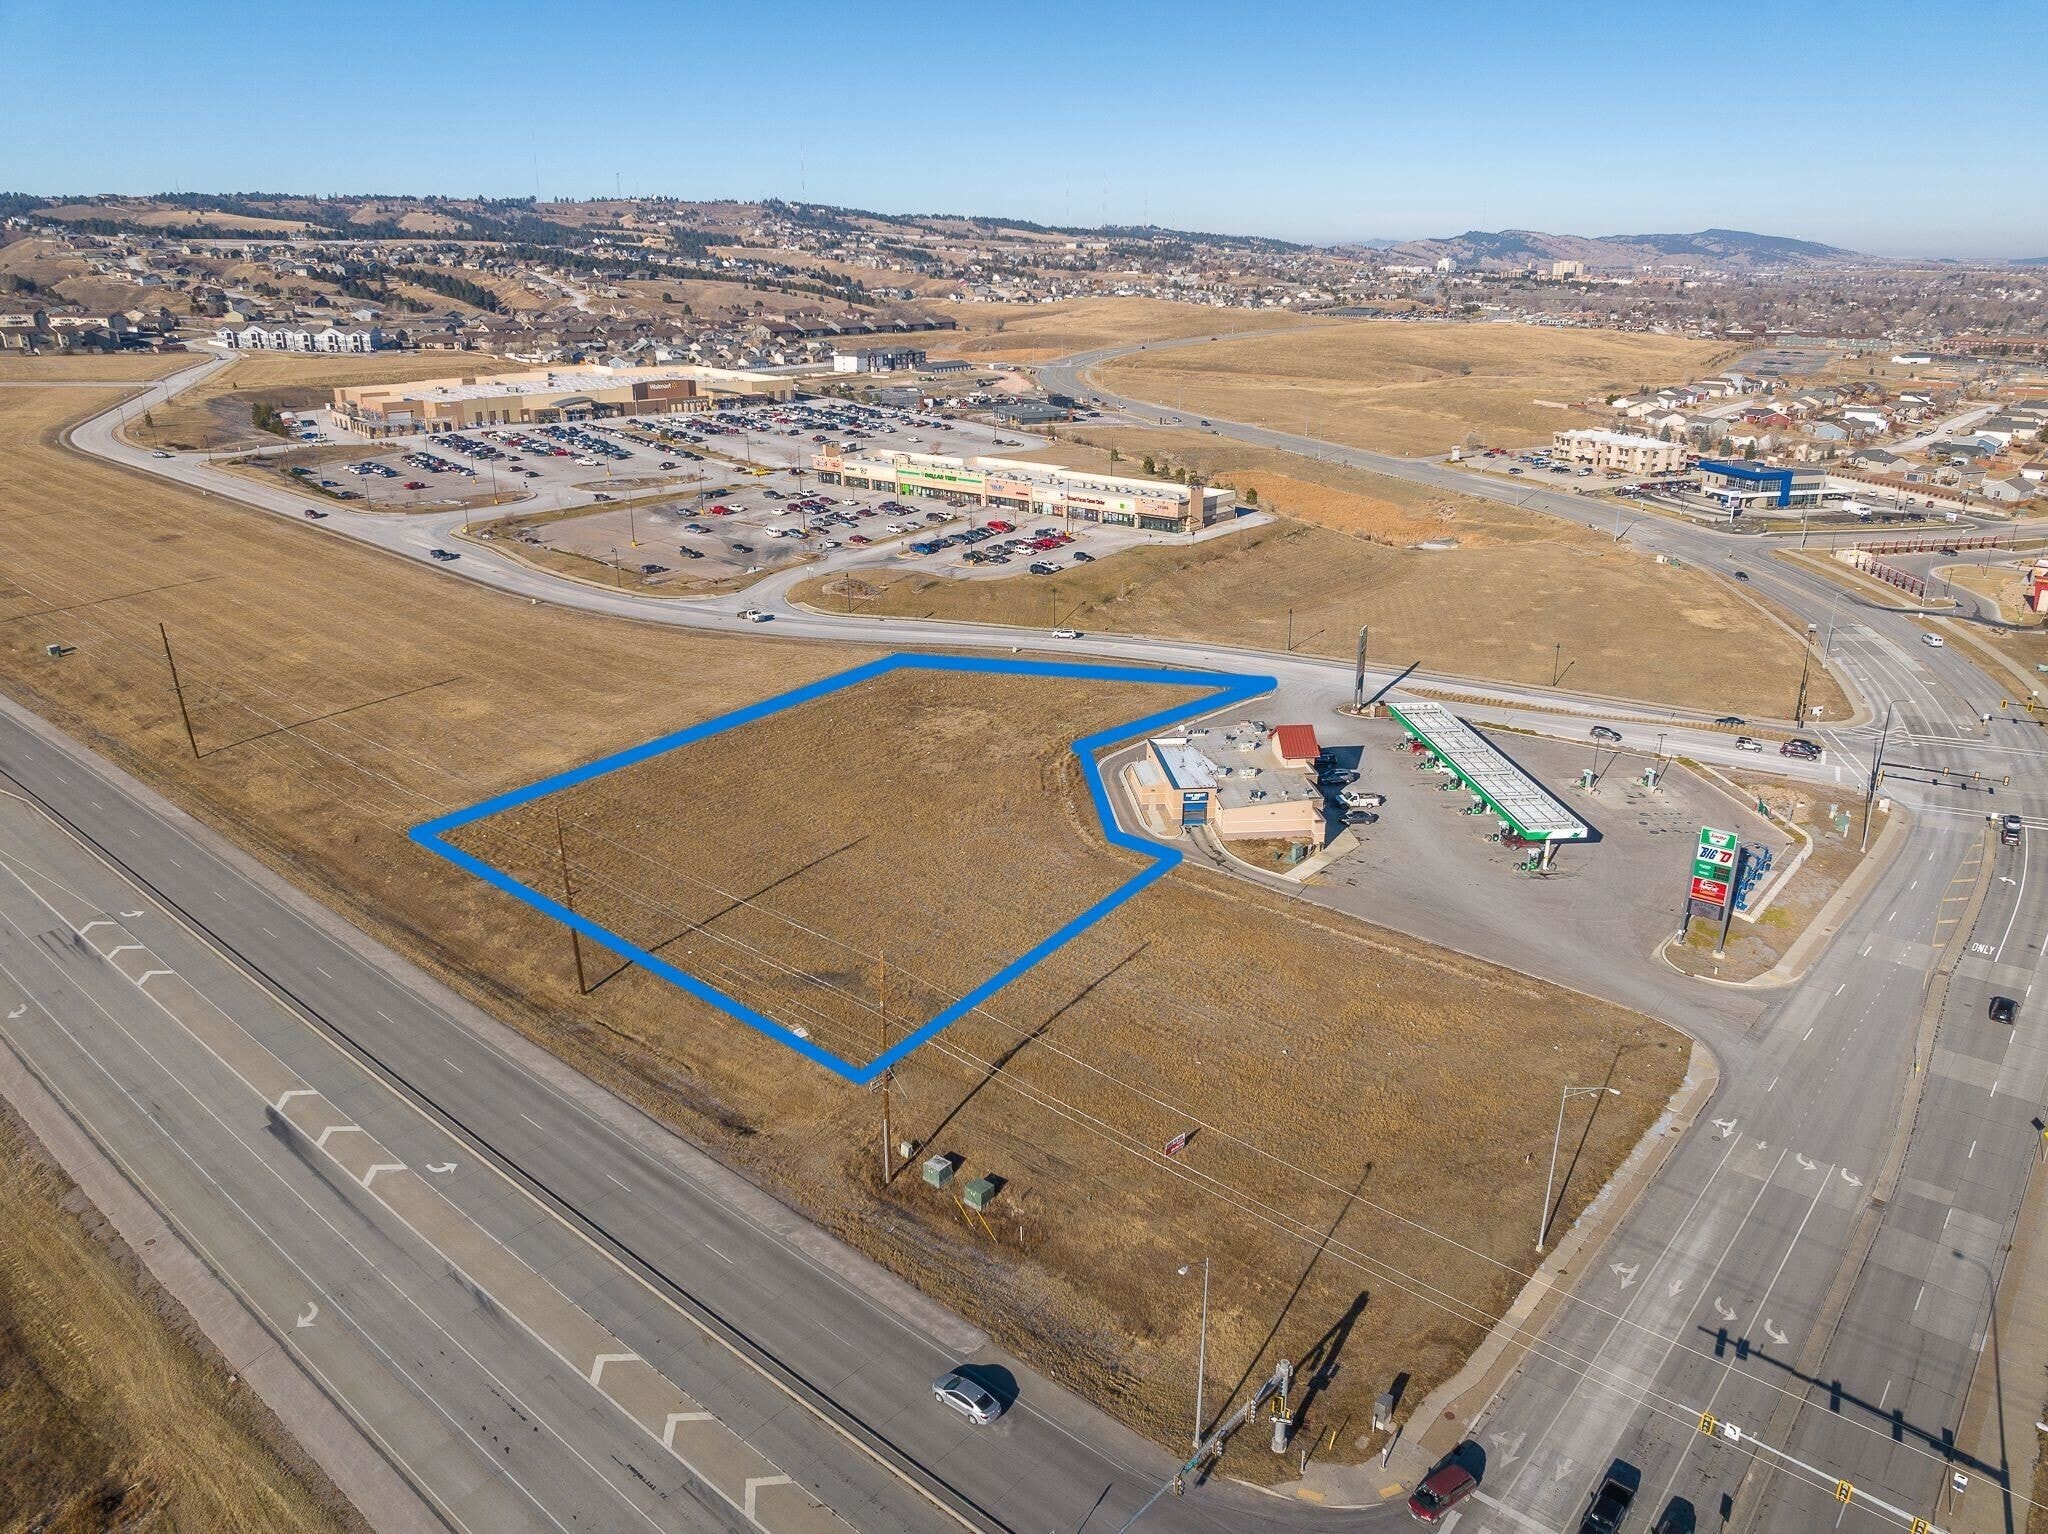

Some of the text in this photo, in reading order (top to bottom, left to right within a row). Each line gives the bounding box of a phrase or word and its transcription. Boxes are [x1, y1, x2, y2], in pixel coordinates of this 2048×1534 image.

[1700, 846, 1733, 863] BIG D
[1971, 942, 1996, 956] ONLY
